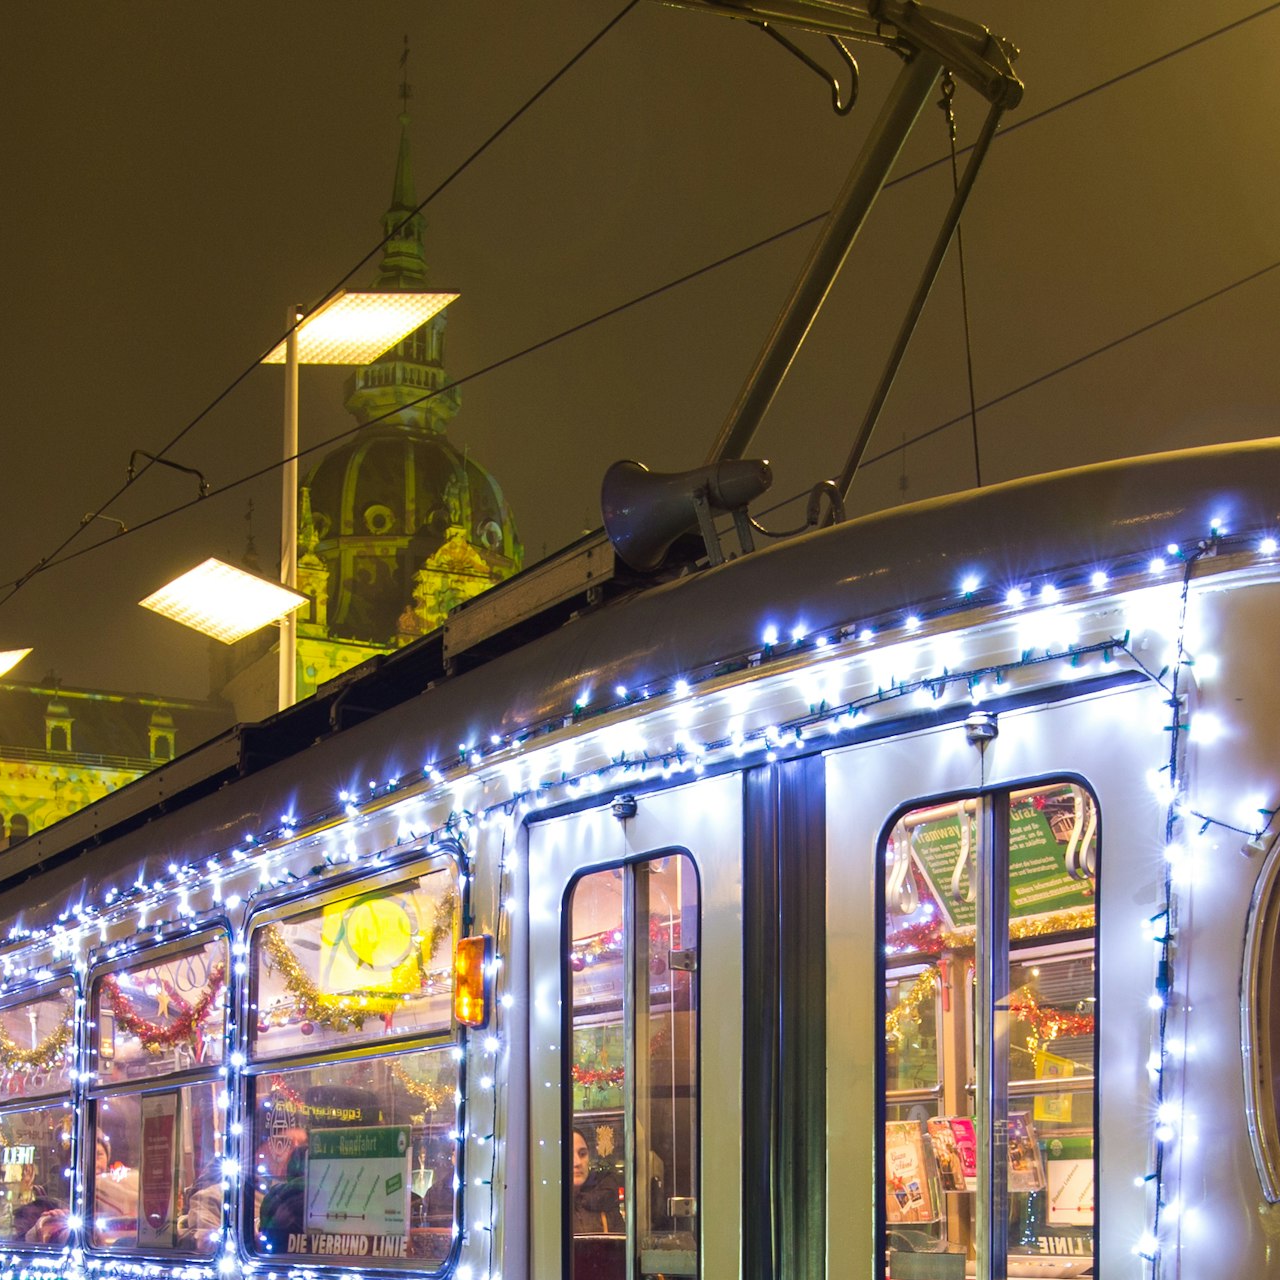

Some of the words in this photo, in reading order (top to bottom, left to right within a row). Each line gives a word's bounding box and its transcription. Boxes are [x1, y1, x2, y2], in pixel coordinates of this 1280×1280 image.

[287, 1233, 307, 1254] DIE
[311, 1233, 369, 1256] VERBUND
[372, 1235, 407, 1258] LINIE
